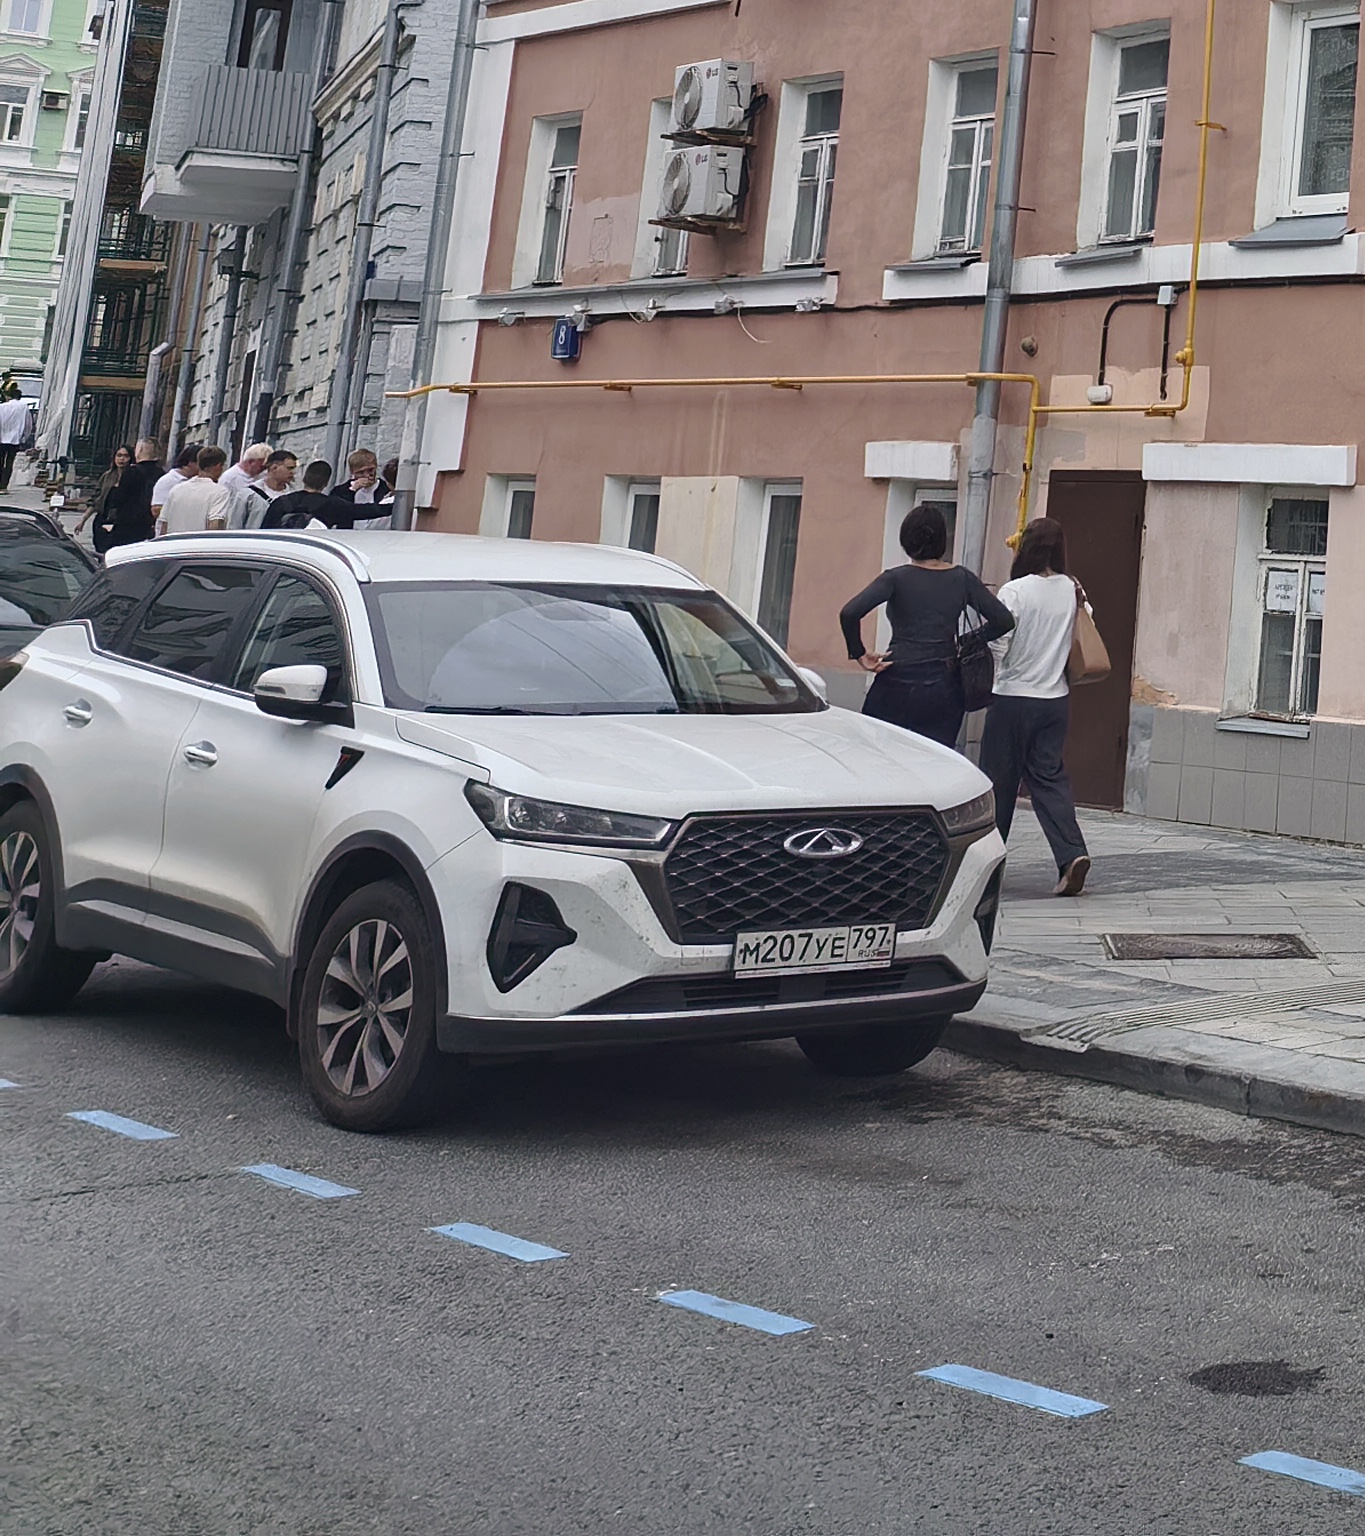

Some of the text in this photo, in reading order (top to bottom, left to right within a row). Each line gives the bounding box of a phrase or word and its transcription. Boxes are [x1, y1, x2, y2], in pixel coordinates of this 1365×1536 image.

[558, 325, 567, 345] 8
[852, 926, 889, 950] 797
[858, 949, 878, 958] RUS
